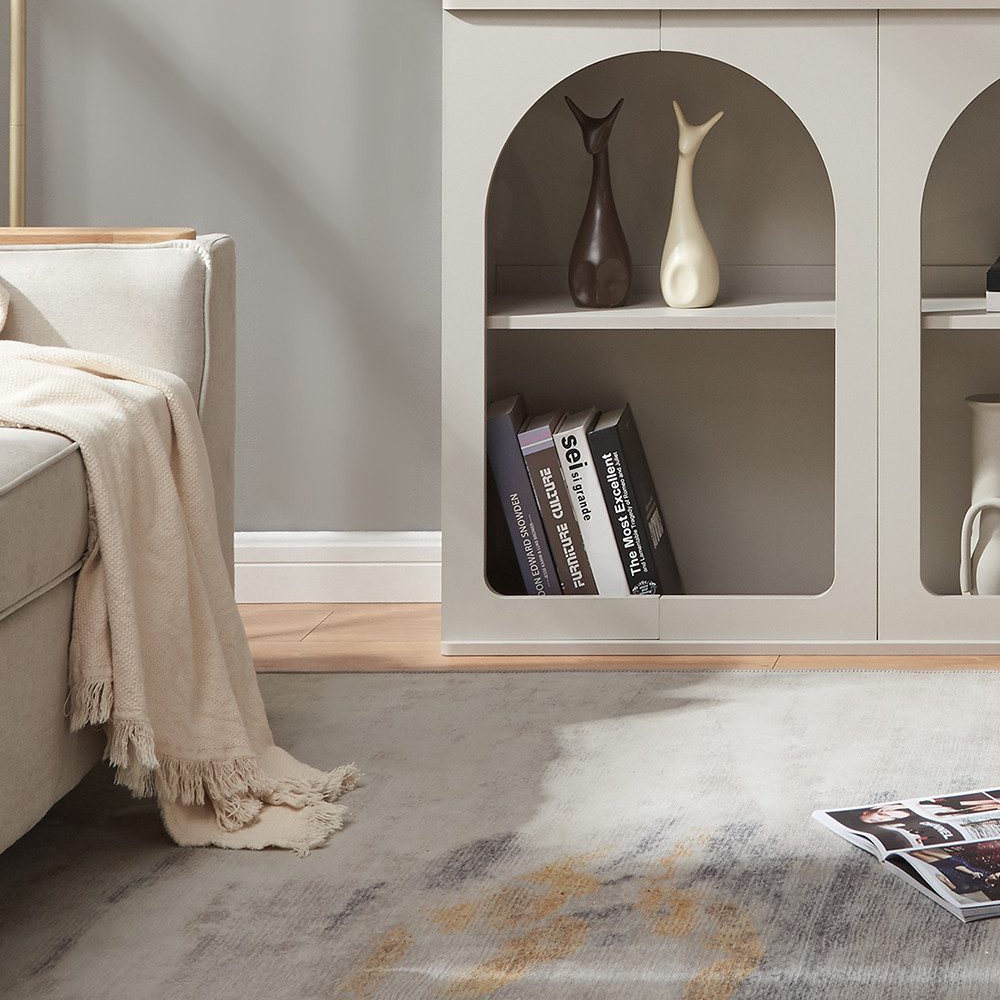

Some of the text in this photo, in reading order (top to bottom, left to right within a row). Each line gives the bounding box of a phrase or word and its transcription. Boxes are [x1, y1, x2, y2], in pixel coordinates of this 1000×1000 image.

[539, 467, 564, 520] CULTURE
[561, 434, 592, 522] sei si grande
[510, 492, 529, 539] SNOWDEN
[601, 452, 641, 576] The Most Excellent
[522, 538, 540, 576] EDWARD
